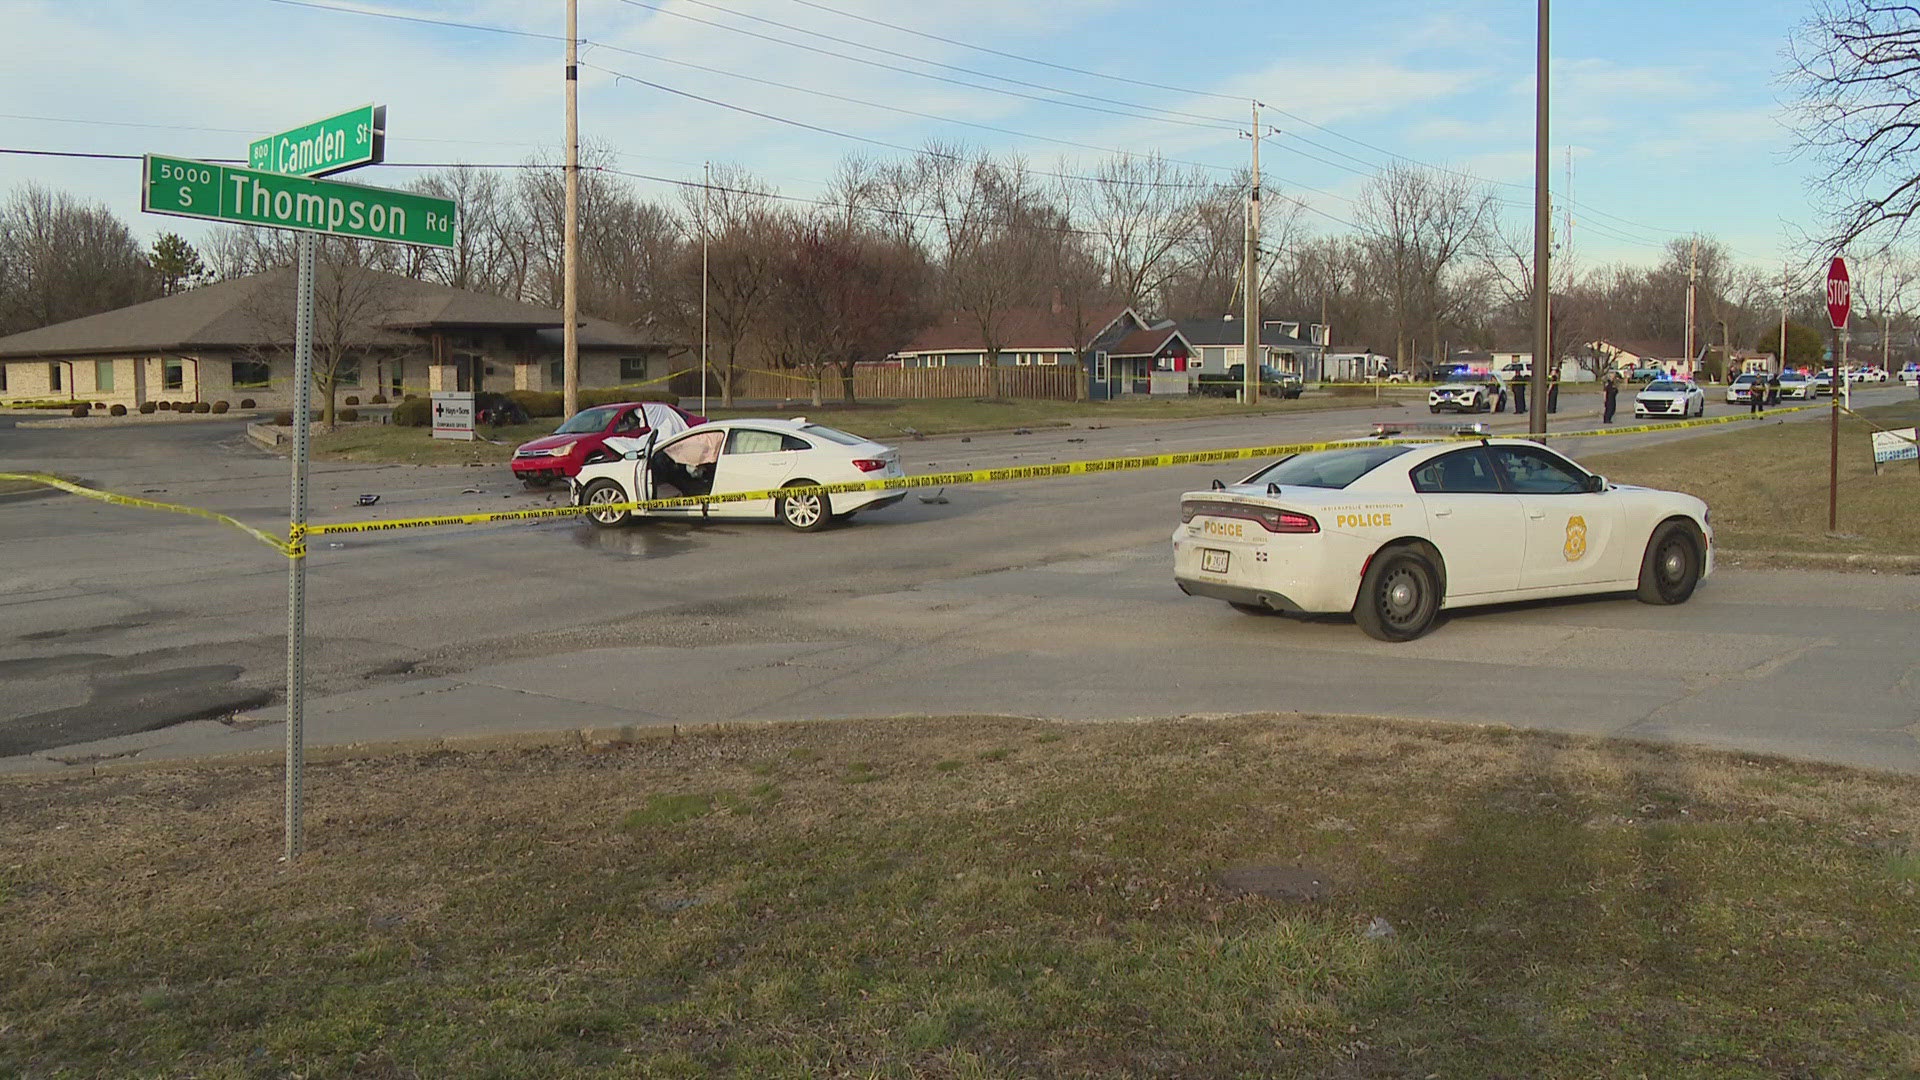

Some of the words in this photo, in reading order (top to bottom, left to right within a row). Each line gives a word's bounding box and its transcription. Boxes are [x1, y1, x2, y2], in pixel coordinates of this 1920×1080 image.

[254, 143, 269, 160] 800
[279, 127, 345, 174] Camden
[356, 122, 368, 145] St
[161, 164, 211, 185] 5000
[178, 185, 193, 207] S
[229, 174, 406, 235] Thompson
[426, 211, 448, 232] Rd
[1828, 279, 1849, 306] STOP
[1204, 521, 1243, 537] POLICE
[1337, 513, 1392, 528] POLICE
